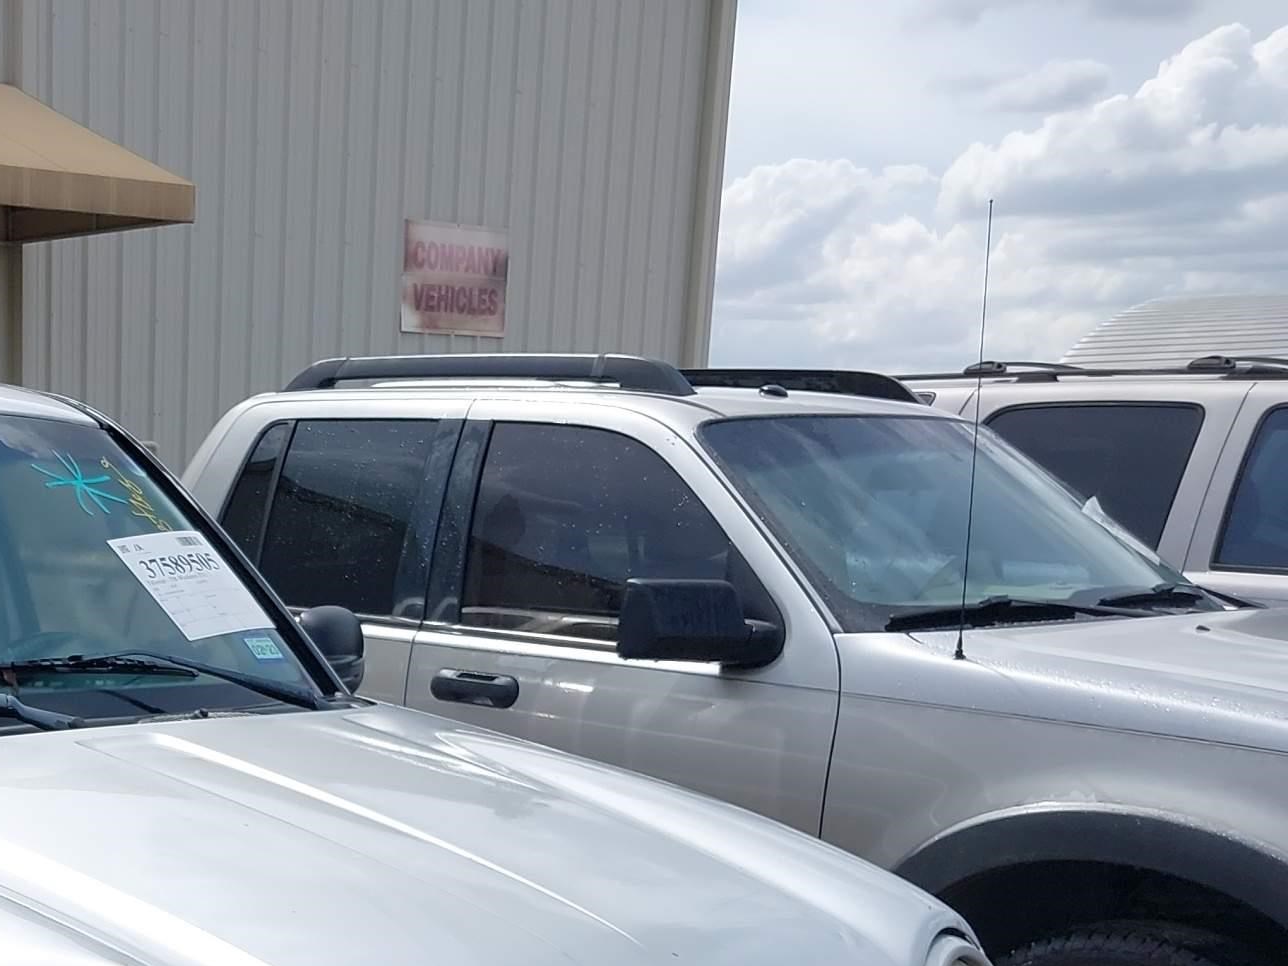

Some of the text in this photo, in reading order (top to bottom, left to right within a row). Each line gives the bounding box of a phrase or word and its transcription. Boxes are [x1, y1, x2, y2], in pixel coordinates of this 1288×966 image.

[414, 240, 505, 276] COMPANY
[413, 283, 498, 315] VEHICLES
[139, 552, 220, 579] 37589505
